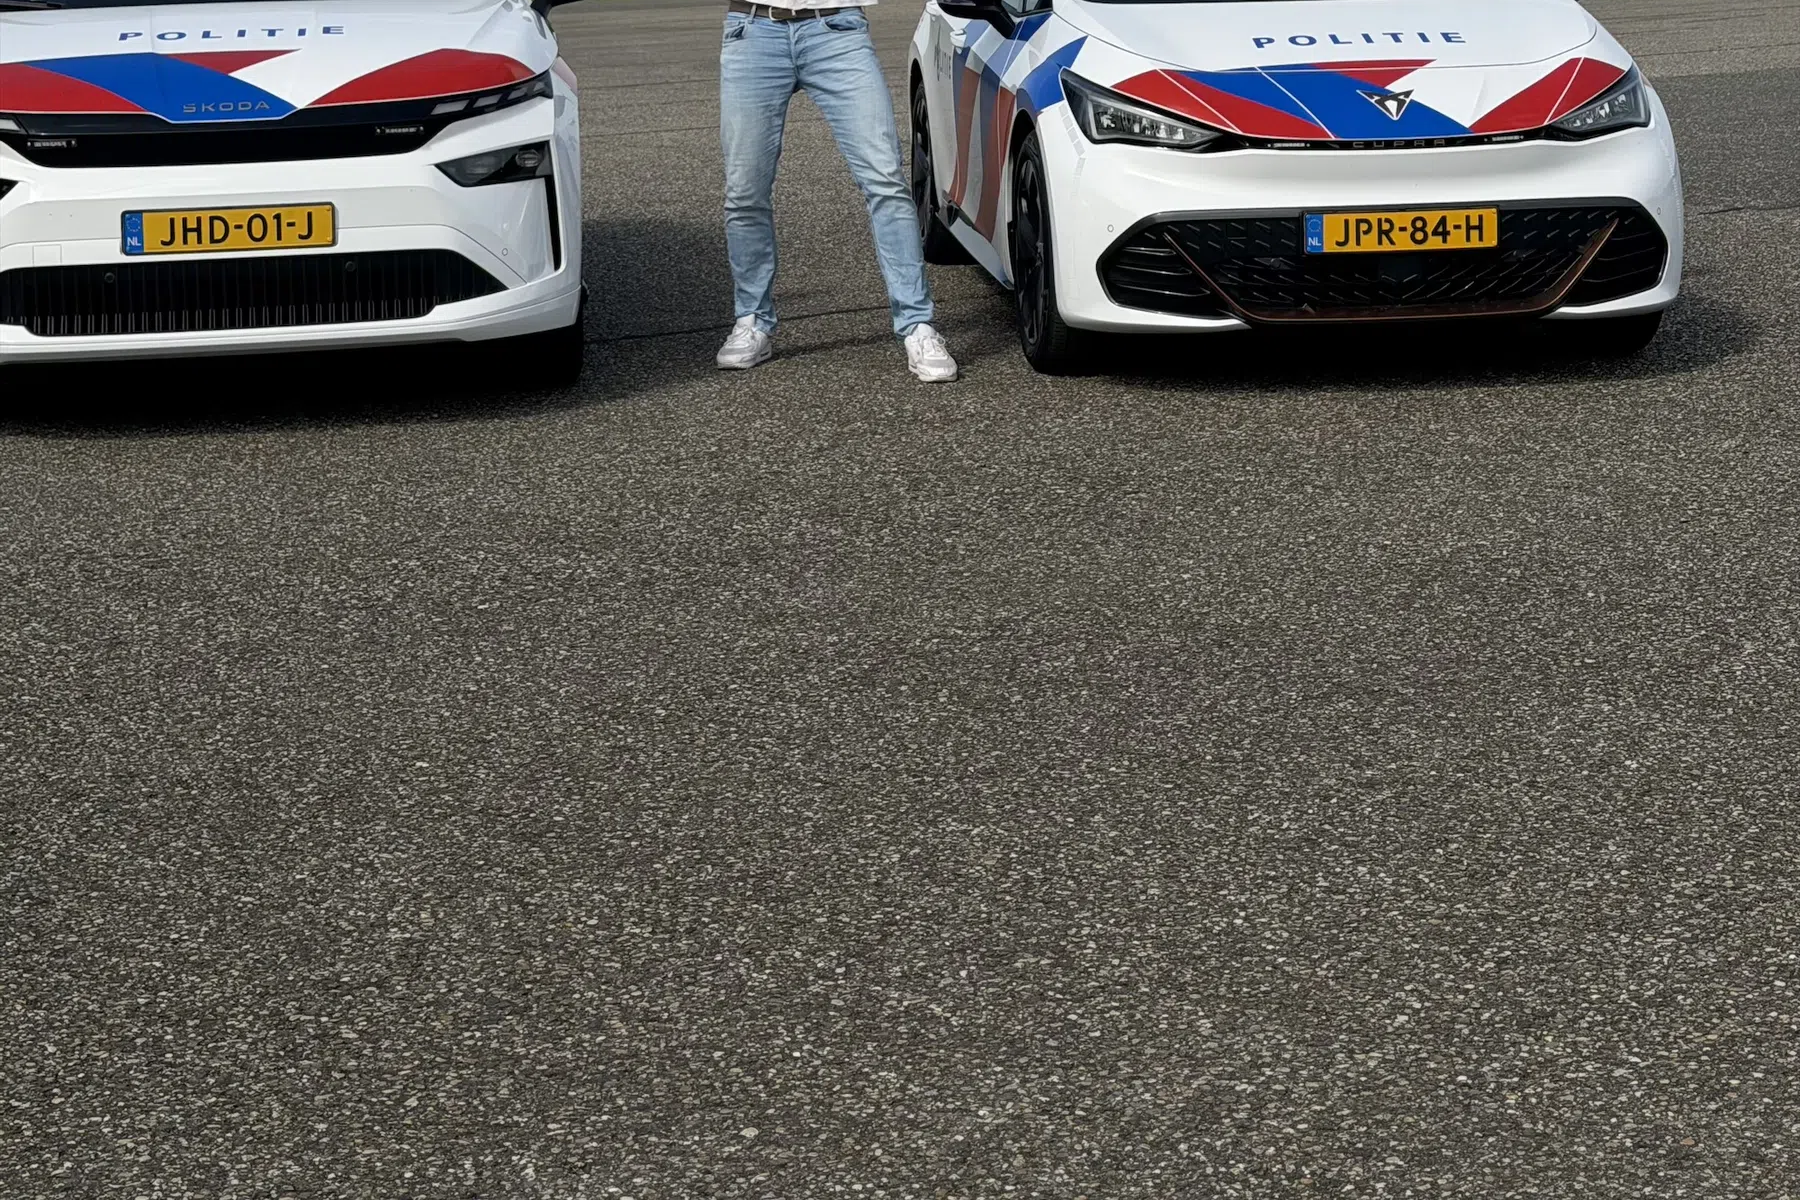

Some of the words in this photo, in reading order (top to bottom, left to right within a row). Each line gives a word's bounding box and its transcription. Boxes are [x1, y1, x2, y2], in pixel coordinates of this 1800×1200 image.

[118, 26, 344, 41] POLITIE
[1252, 32, 1466, 49] POLITIE
[1352, 139, 1446, 148] CUPRA
[160, 211, 313, 246] JHD-01-J
[1335, 214, 1484, 247] JPR-84-H
[127, 236, 141, 246] NL
[1308, 237, 1321, 246] NL
